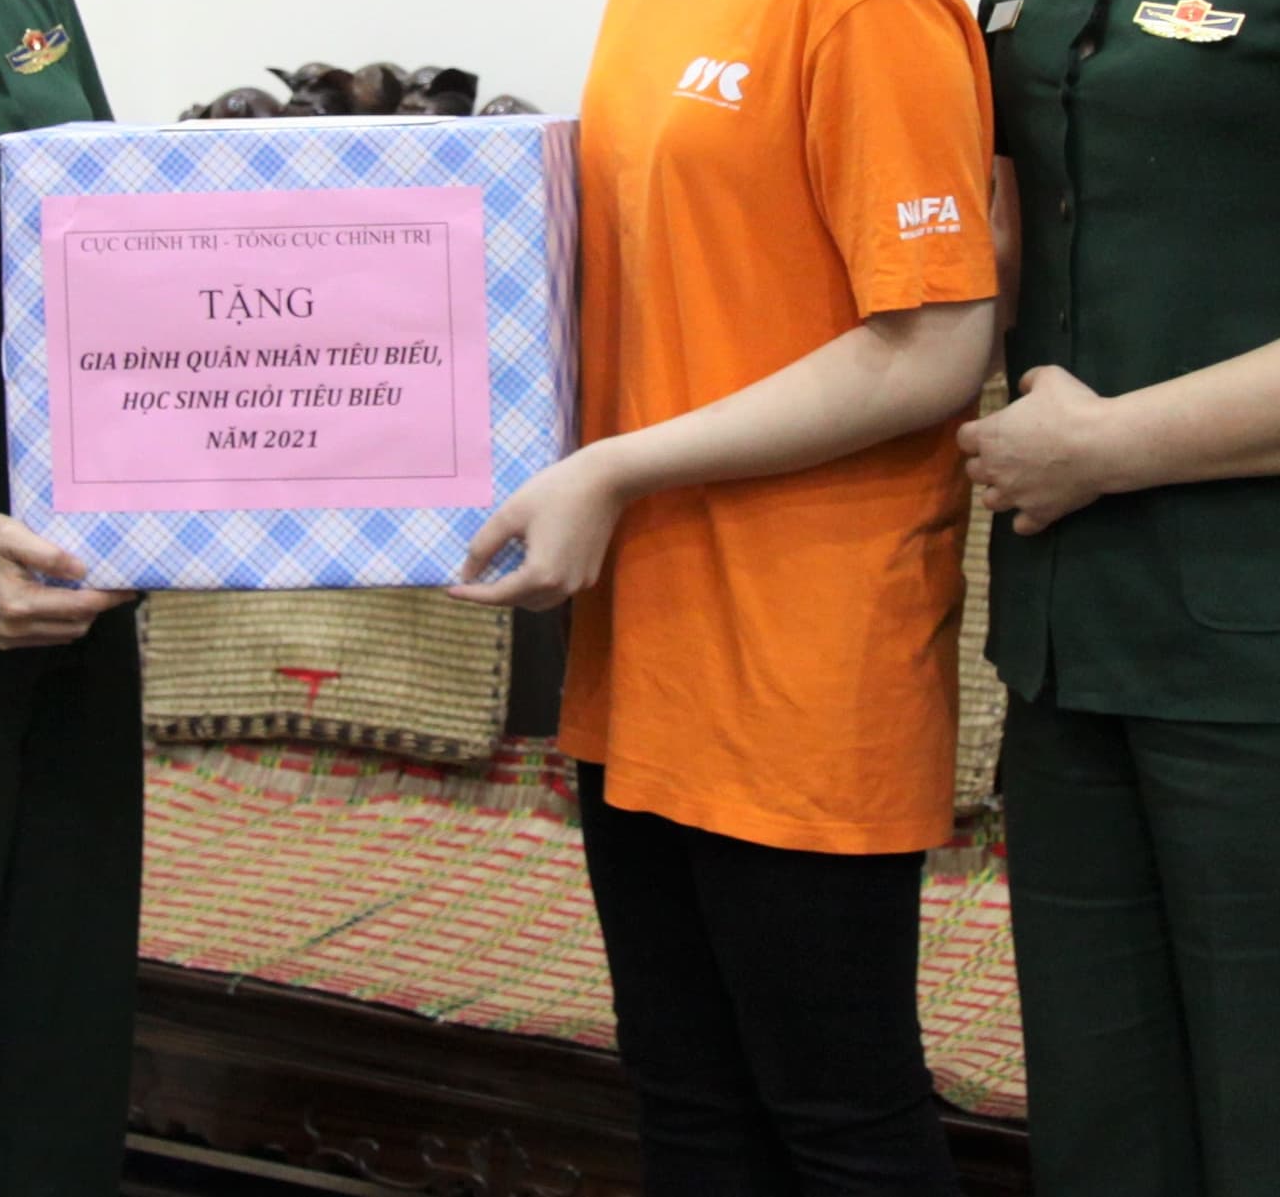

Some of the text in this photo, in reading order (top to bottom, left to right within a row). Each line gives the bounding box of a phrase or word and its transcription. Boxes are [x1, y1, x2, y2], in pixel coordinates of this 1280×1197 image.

[80, 235, 120, 255] CỤC
[189, 234, 218, 253] TRỊ
[291, 231, 330, 249] CỤC
[400, 228, 432, 247] TRỊ
[198, 283, 315, 327] TẶNG
[79, 351, 117, 371] GIA
[122, 345, 181, 371] ĐÌNH
[186, 344, 250, 374] QUÂN
[255, 343, 321, 368] NHÂN
[326, 341, 379, 366] TIÊU
[121, 390, 171, 416] HỌC
[173, 389, 230, 410] SINH
[234, 383, 284, 409] GIỎI
[289, 383, 344, 408] TIÊU
[205, 425, 319, 450] NĂM 2021
